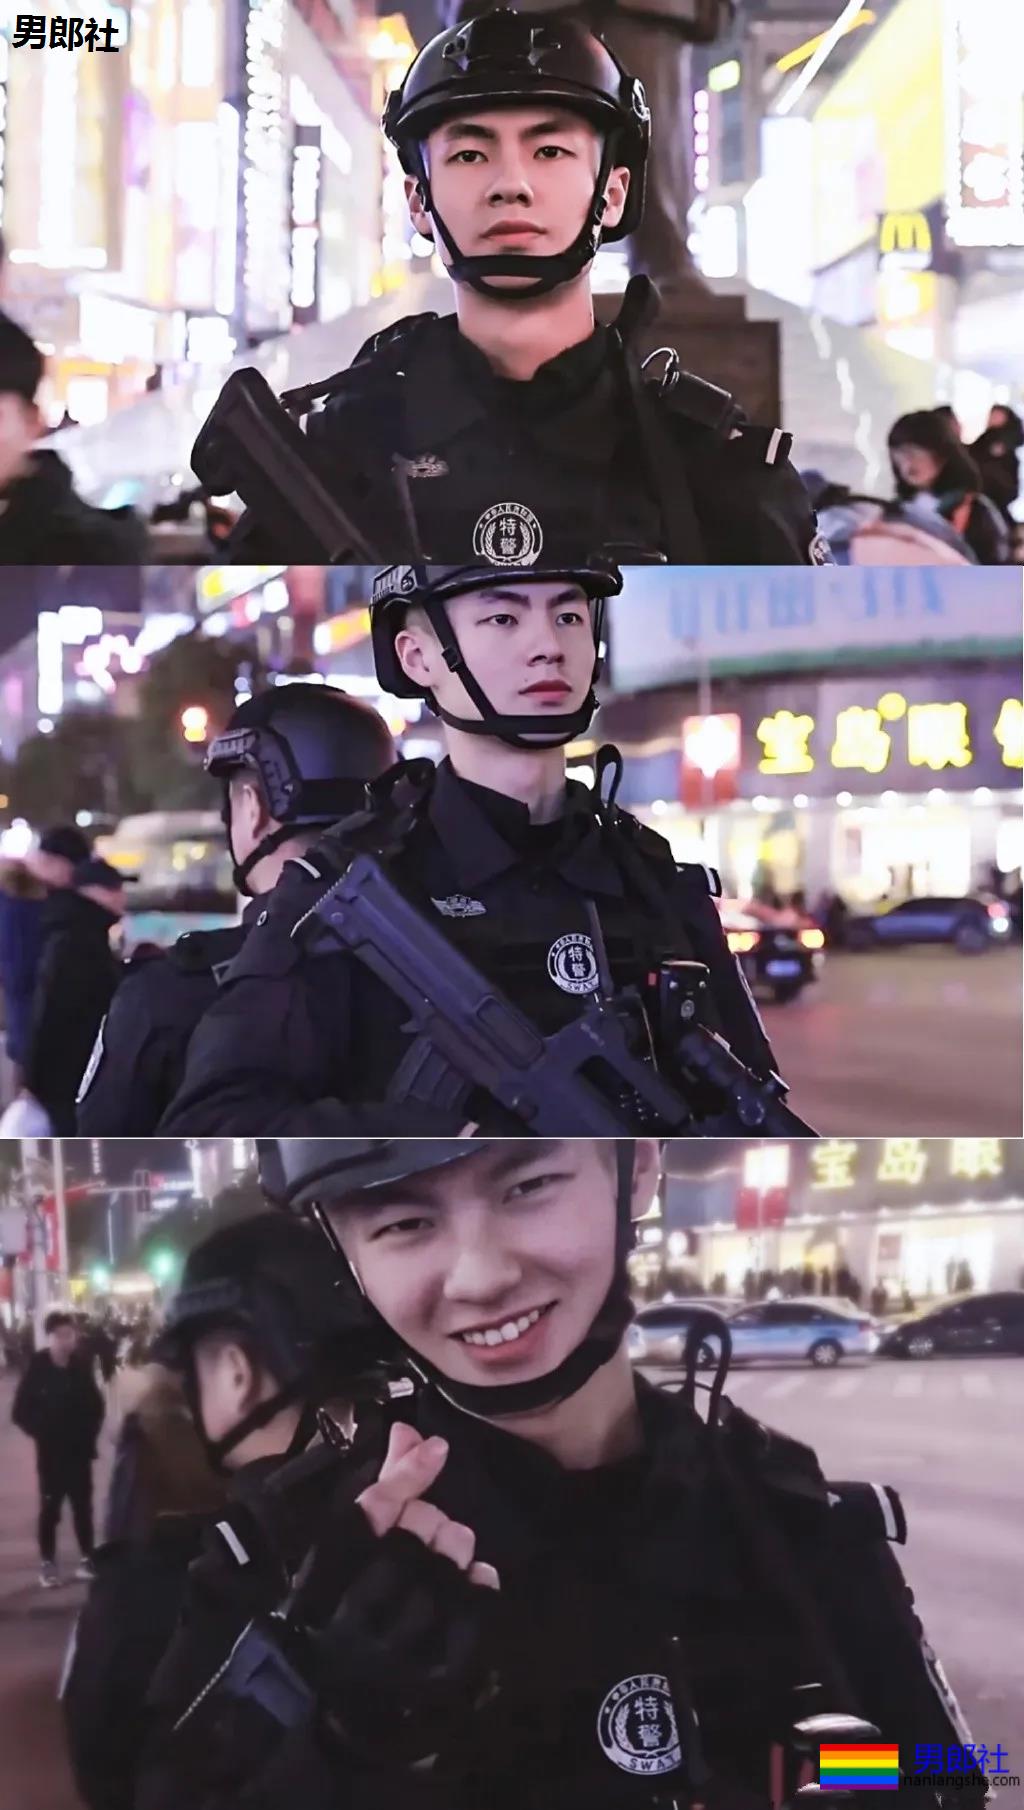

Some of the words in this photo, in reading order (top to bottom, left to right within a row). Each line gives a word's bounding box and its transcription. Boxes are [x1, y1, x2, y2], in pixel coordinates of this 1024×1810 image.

[499, 517, 517, 555] 特警
[568, 945, 586, 977] 特警
[634, 1696, 662, 1747] 特警
